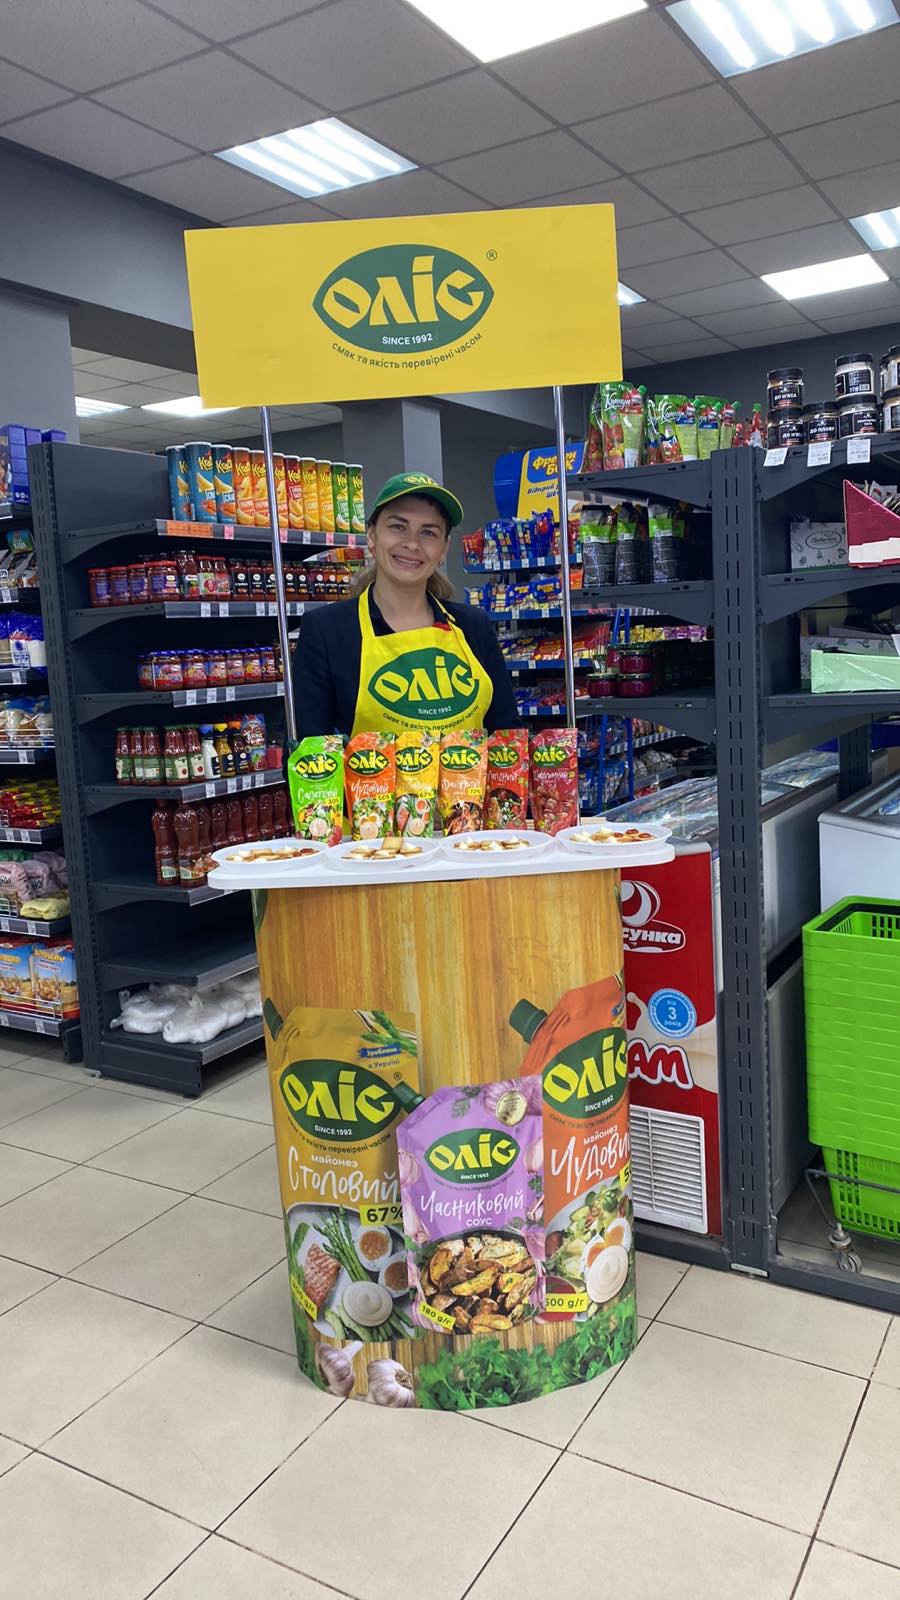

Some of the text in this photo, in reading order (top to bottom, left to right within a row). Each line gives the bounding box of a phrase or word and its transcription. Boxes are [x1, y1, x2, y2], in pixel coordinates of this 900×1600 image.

[382, 333, 433, 345] SINCE 1992
[332, 333, 483, 369] смак та якість перевірені часом
[438, 706, 452, 714] 1992
[383, 712, 400, 725] смак
[410, 723, 431, 731] якість
[668, 1006, 678, 1020] 3
[584, 1101, 601, 1112] SINCE
[314, 1124, 335, 1135] SINCE
[584, 1125, 618, 1145] майонез
[312, 1154, 358, 1168] майонез
[288, 1146, 399, 1203] Столовий
[420, 1189, 524, 1223] Часниковий
[367, 1206, 403, 1224] 67%
